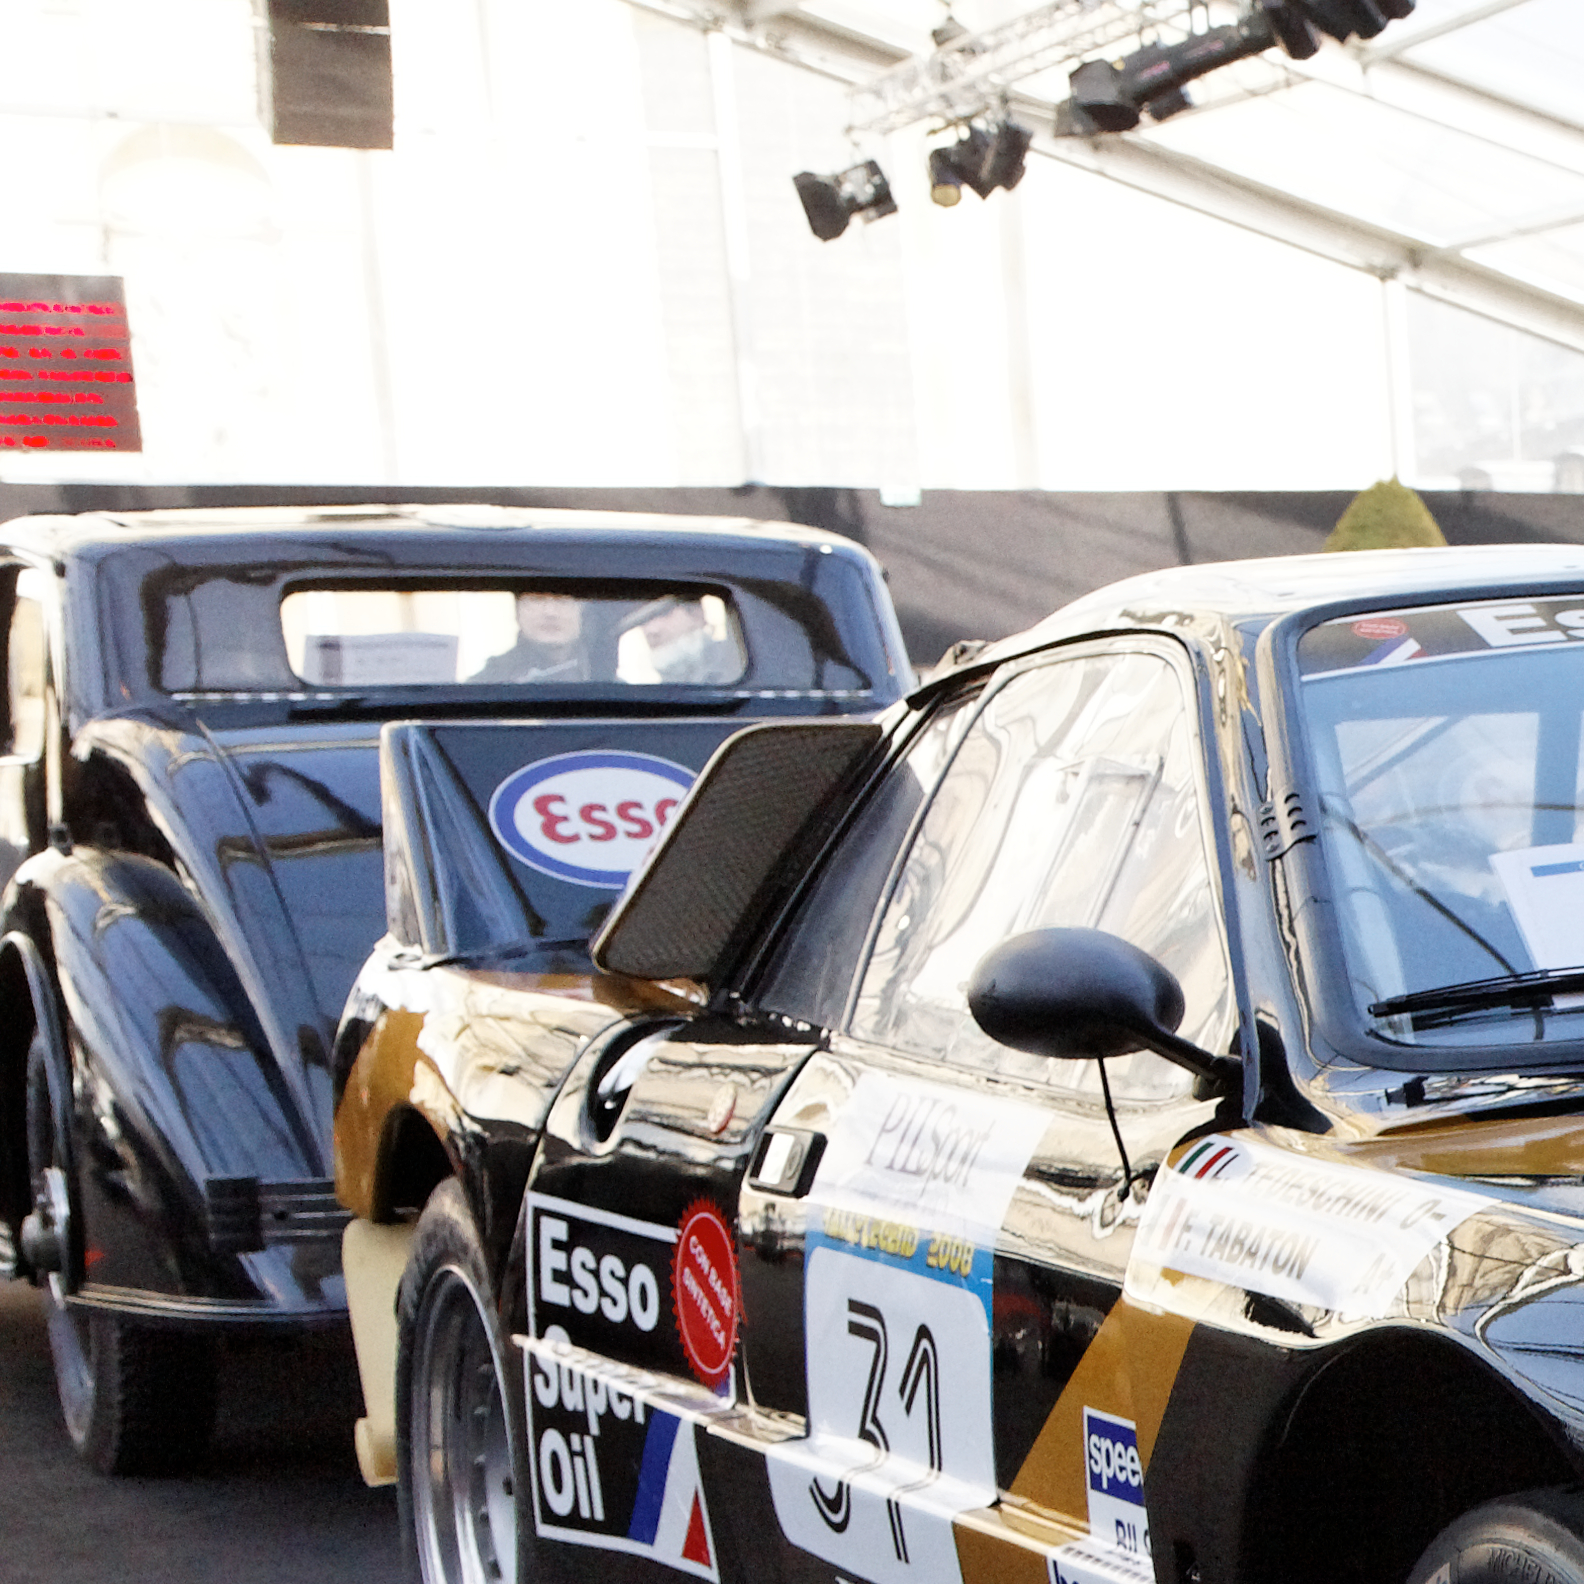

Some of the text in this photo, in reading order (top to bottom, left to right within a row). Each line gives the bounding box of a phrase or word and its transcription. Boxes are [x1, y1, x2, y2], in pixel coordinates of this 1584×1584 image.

[539, 1214, 660, 1332] Esso
[926, 1230, 976, 1278] 2008
[1199, 1218, 1321, 1281] TABATON
[809, 1298, 943, 1565] 31
[1088, 1433, 1144, 1490] spee
[539, 1427, 606, 1522] Oil
